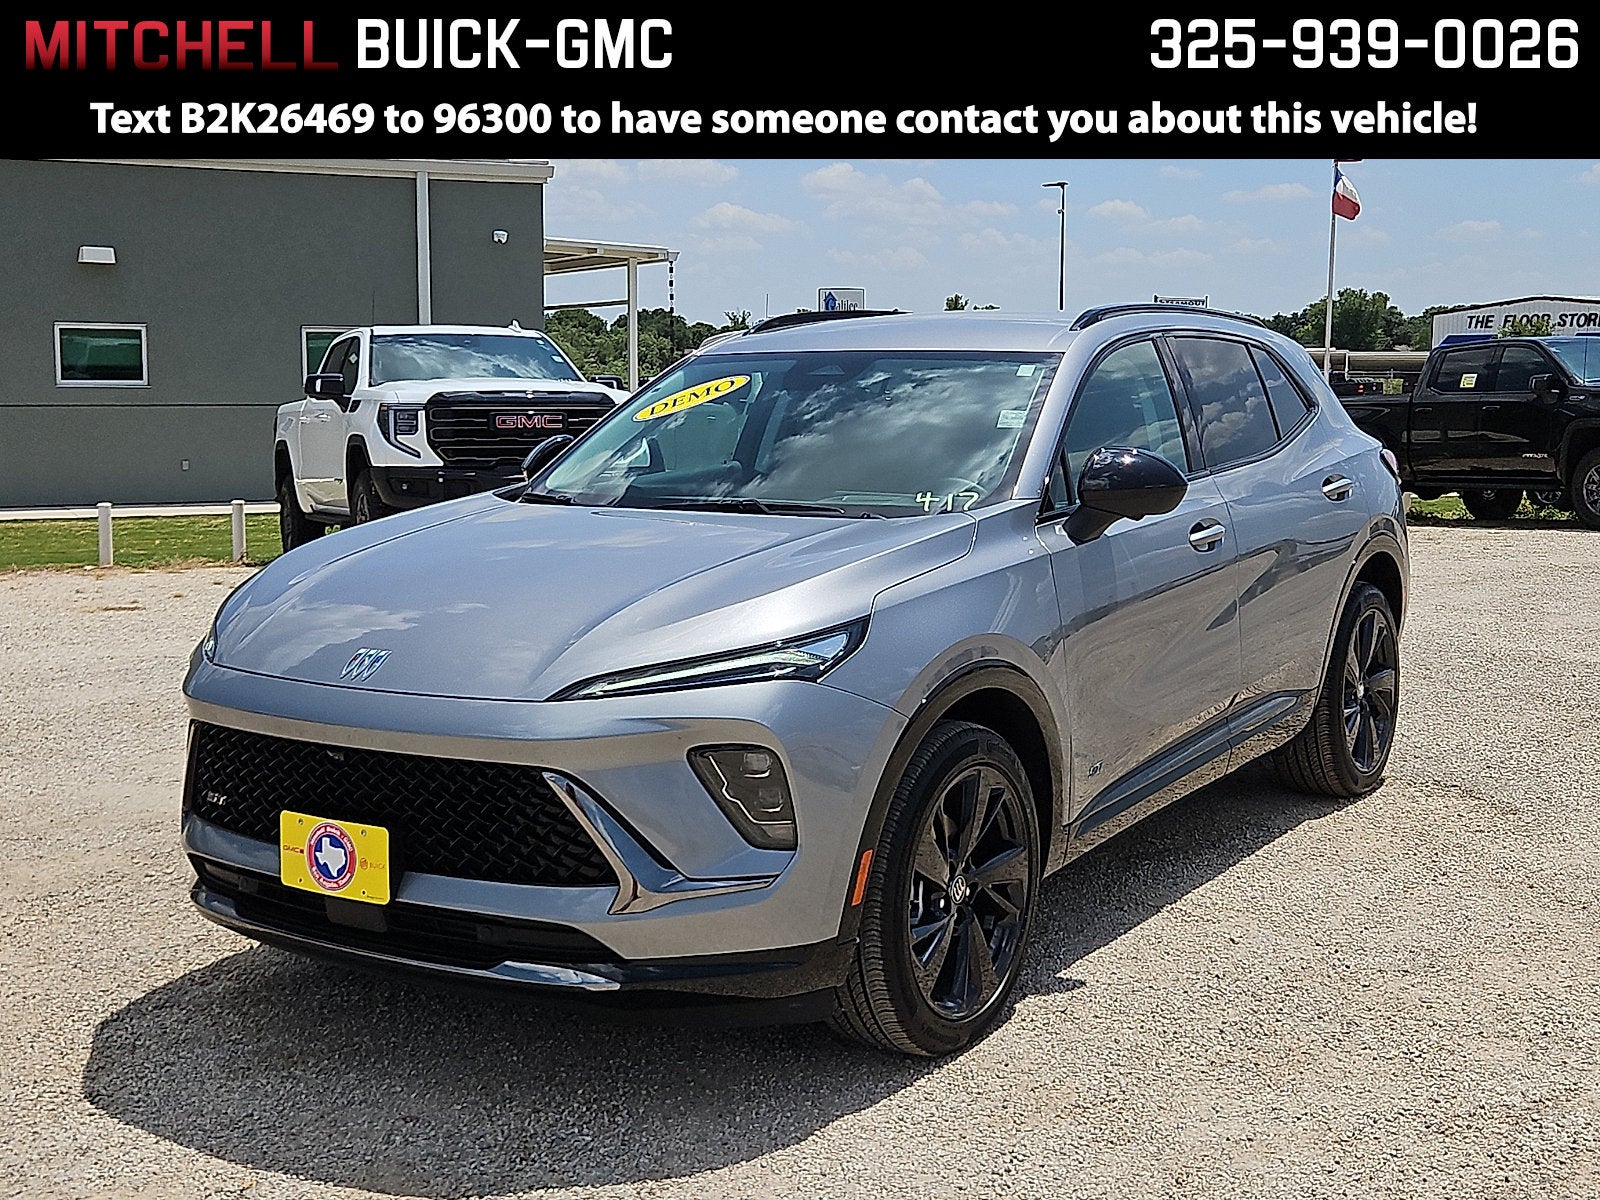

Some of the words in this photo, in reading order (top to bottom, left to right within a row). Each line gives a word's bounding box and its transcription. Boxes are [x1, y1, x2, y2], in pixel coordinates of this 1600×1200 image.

[1466, 314, 1495, 329] THE
[1557, 312, 1600, 328] STOR
[649, 380, 735, 416] DEMO
[496, 415, 563, 428] GMC
